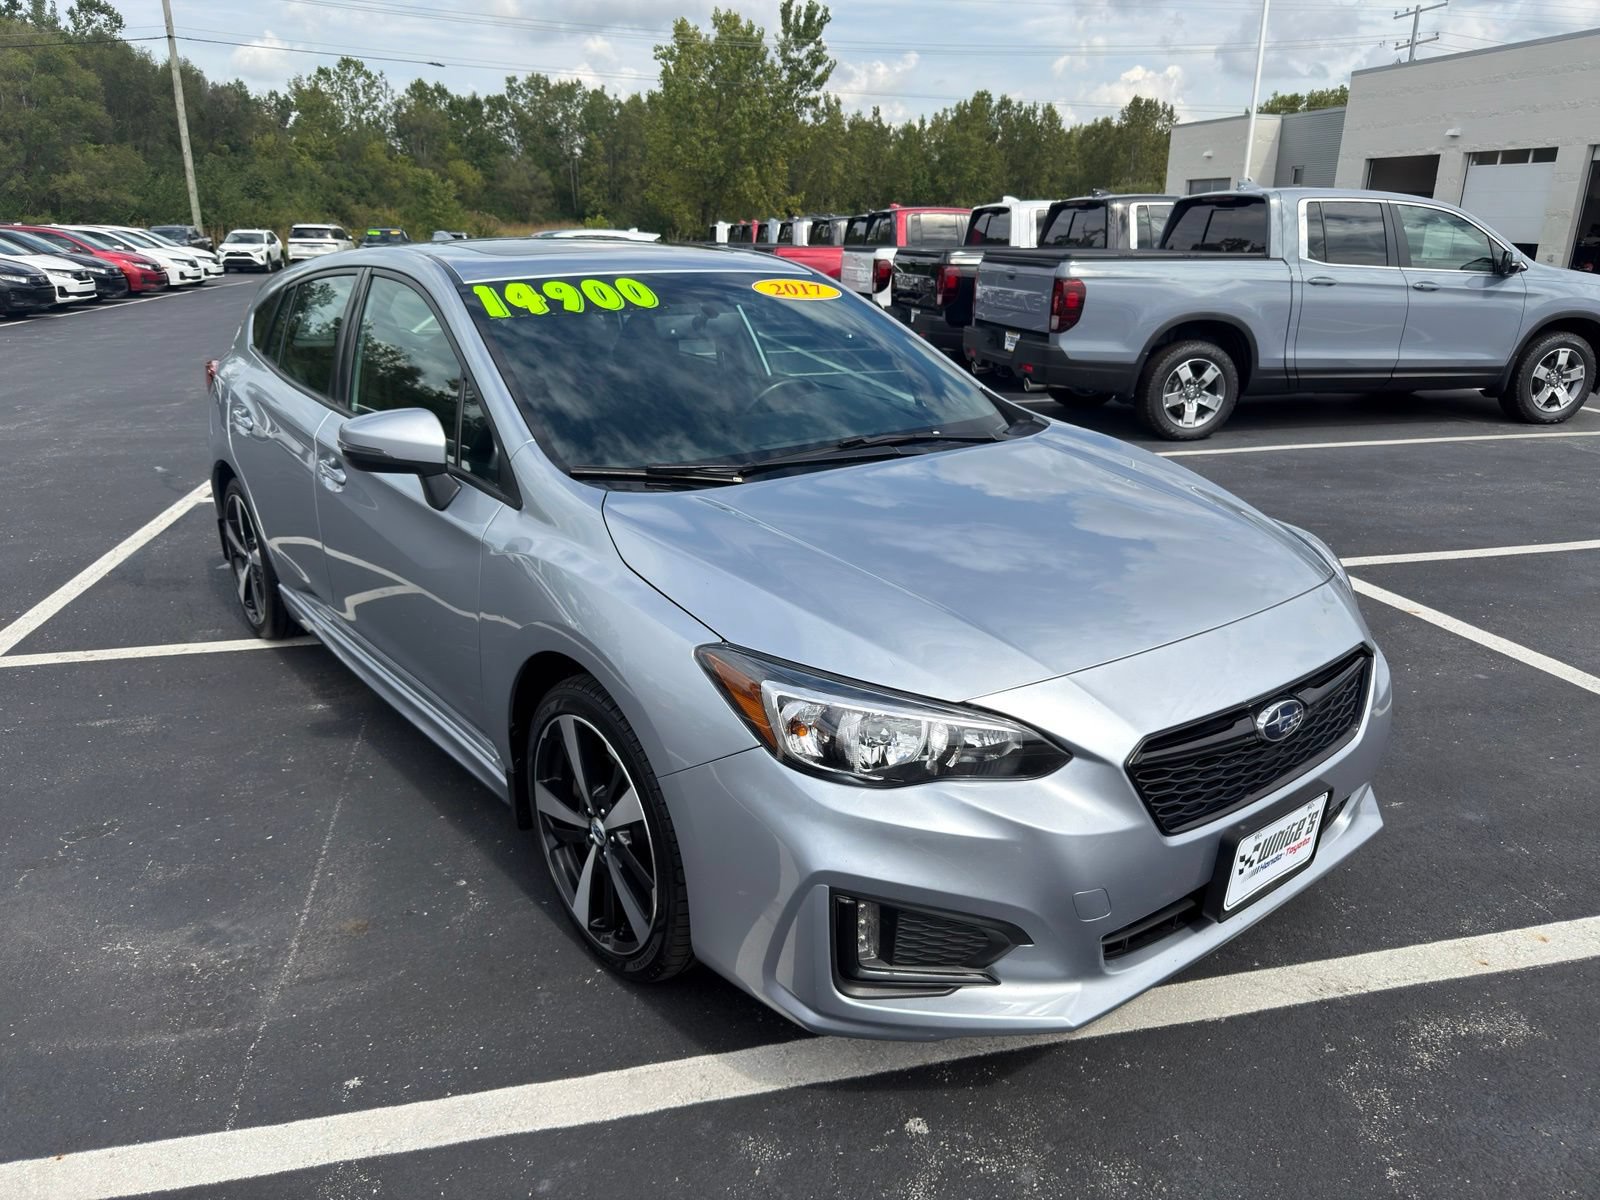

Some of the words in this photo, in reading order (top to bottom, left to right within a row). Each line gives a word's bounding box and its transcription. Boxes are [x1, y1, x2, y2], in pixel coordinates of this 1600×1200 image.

[472, 277, 660, 318] 14900
[769, 283, 820, 296] 2017
[1286, 837, 1310, 856] Toyota
